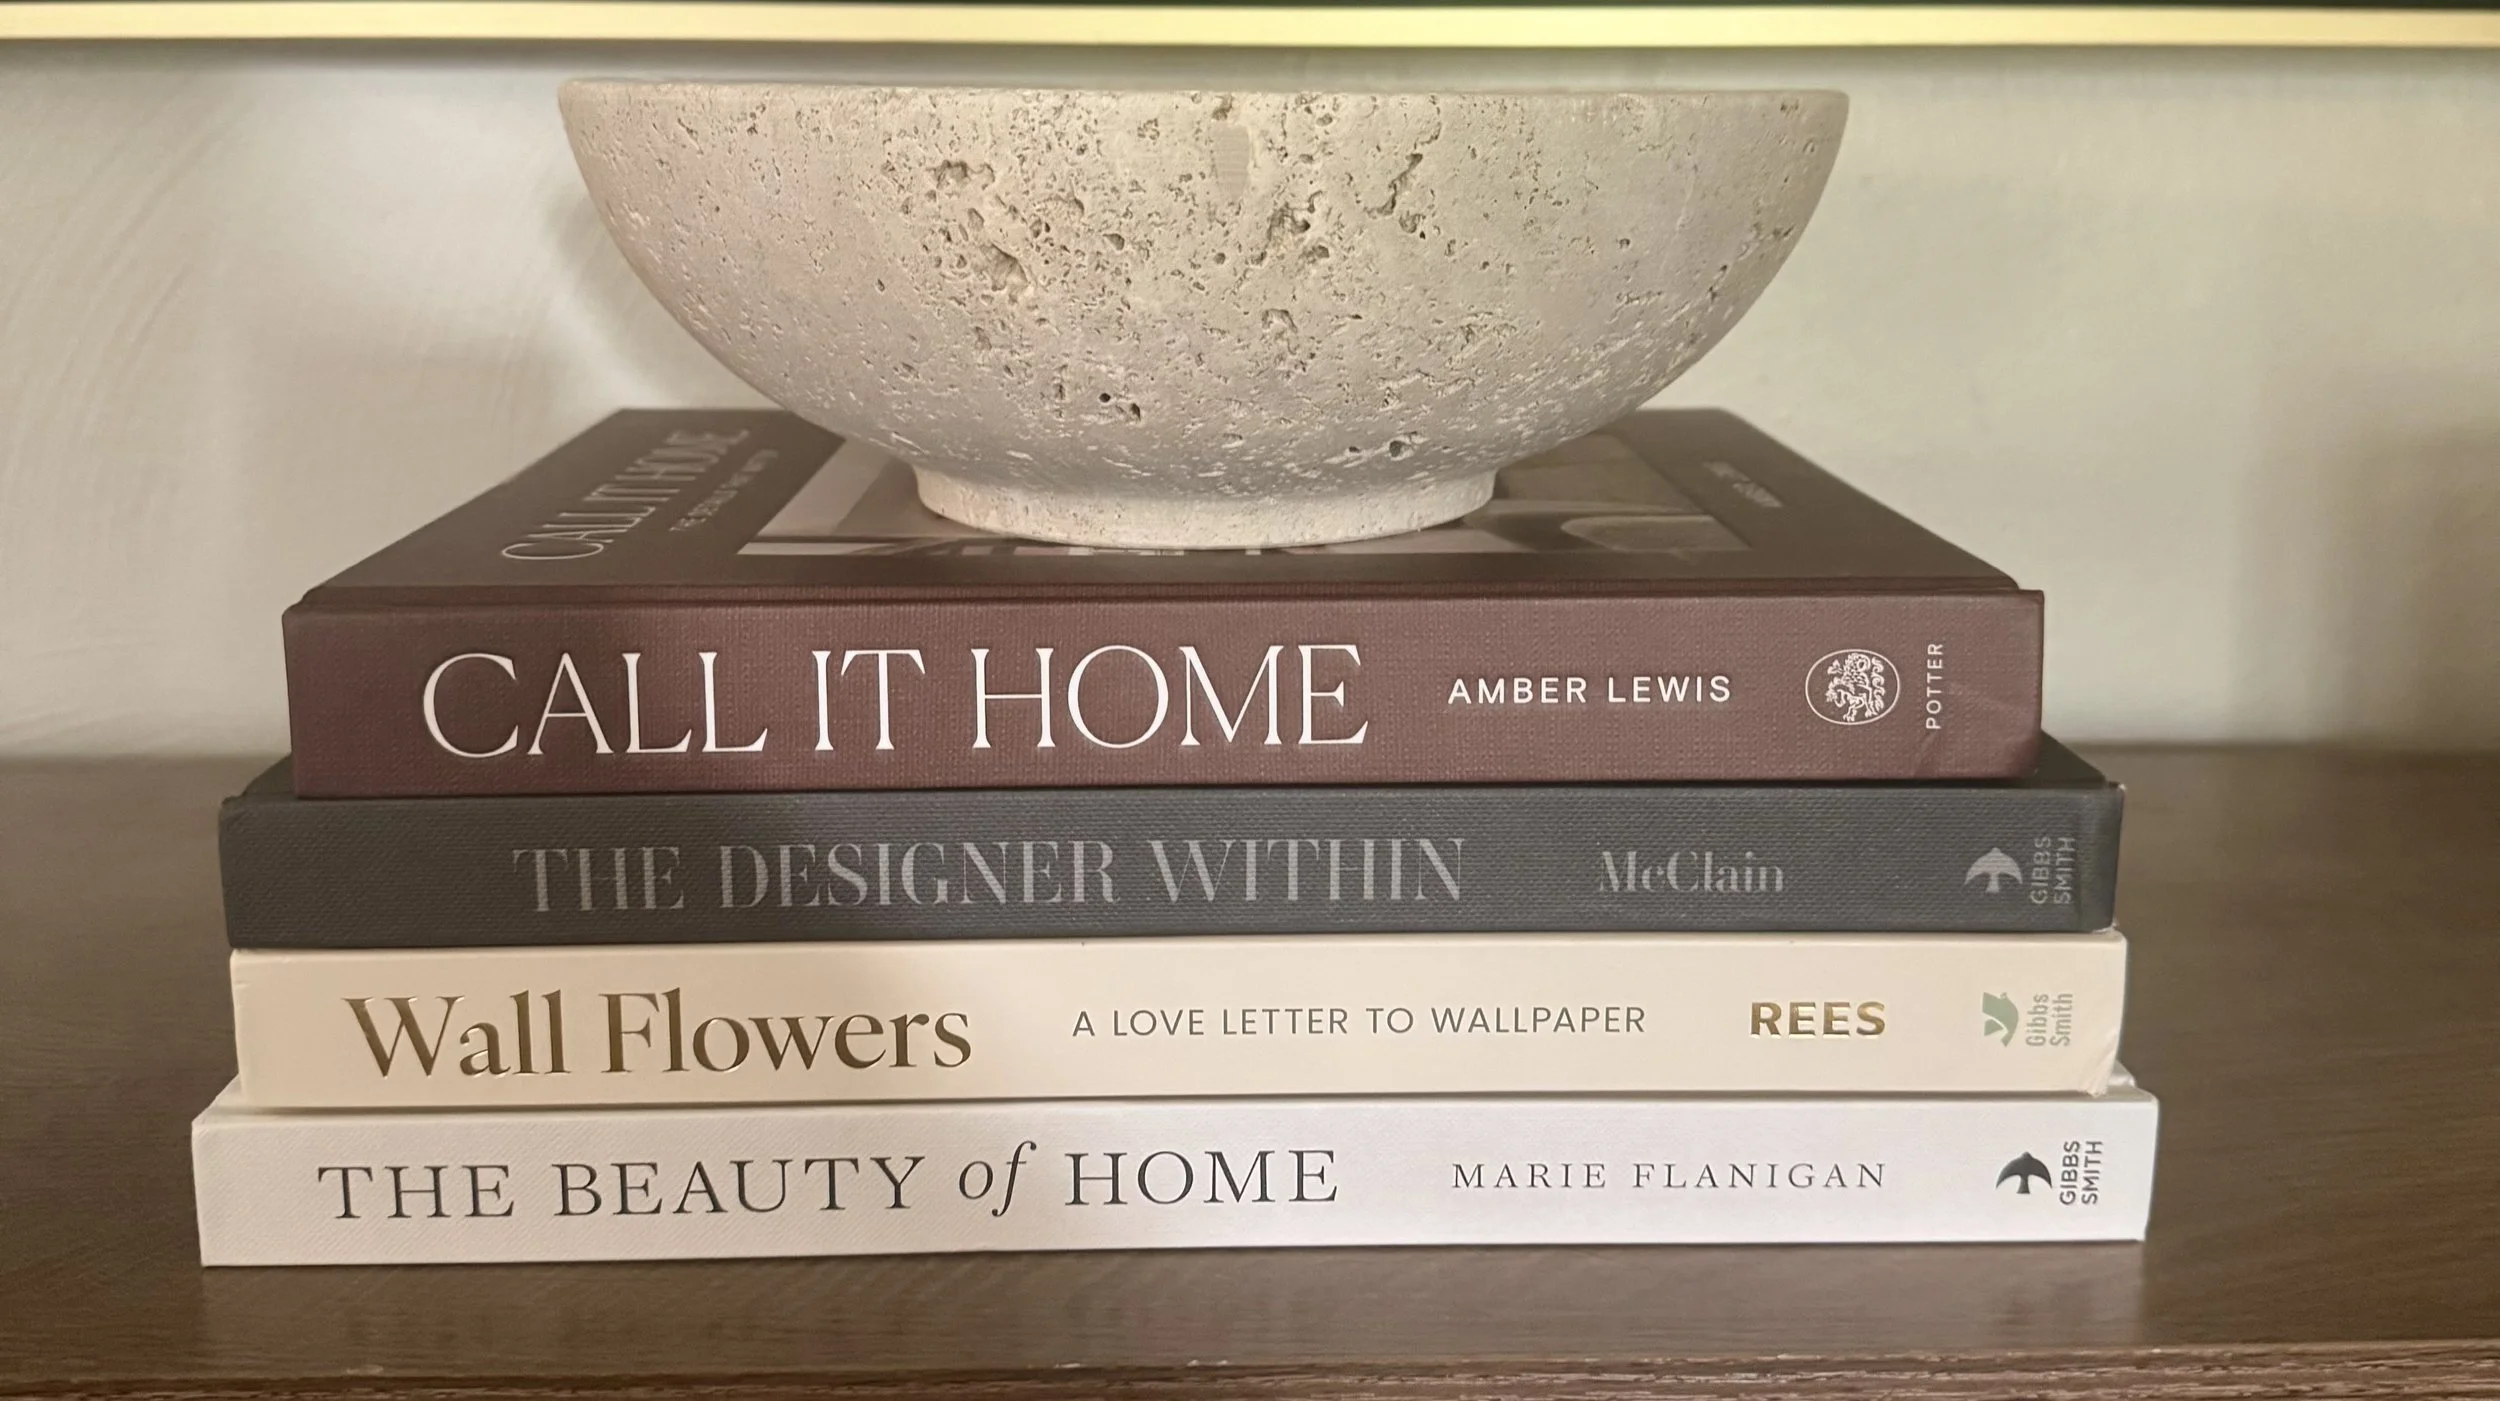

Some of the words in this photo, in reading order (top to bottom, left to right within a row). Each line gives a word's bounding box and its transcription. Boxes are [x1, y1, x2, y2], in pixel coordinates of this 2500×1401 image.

[502, 506, 656, 560] CALL
[422, 651, 768, 758] CALL
[811, 648, 926, 751] IT
[970, 644, 1369, 749] HOME
[1447, 677, 1588, 705] AMBER
[1607, 675, 1731, 703] LEWIS
[1925, 643, 1945, 730] POTTER
[512, 845, 685, 912] THE
[719, 840, 1120, 909] DESIGNER
[1146, 837, 1465, 902] WITHIN
[1599, 850, 1785, 893] McClain
[2029, 836, 2052, 905] GIBBS
[2053, 836, 2077, 905] SMITH
[340, 988, 572, 1079] Wall
[598, 987, 972, 1073] Flowers
[1072, 1010, 1096, 1037] A
[1113, 1009, 1205, 1037] LOVE
[1222, 1008, 1348, 1036] LETTER
[1365, 1007, 1414, 1035] TO
[1430, 1006, 1646, 1034] WALLPAPER
[1750, 1001, 1887, 1037] REES
[2025, 993, 2049, 1047] Gibbs
[2050, 993, 2073, 1047] Smith
[317, 1165, 515, 1219] THE
[551, 1155, 926, 1217] BEAUTY
[958, 1140, 1038, 1217] of
[1064, 1149, 1338, 1207] HOME
[1451, 1162, 1607, 1189] MARIE
[1632, 1162, 1887, 1189] FLANIGAN
[2059, 1140, 2080, 1205] GIBBS
[2081, 1140, 2104, 1205] SMITH
